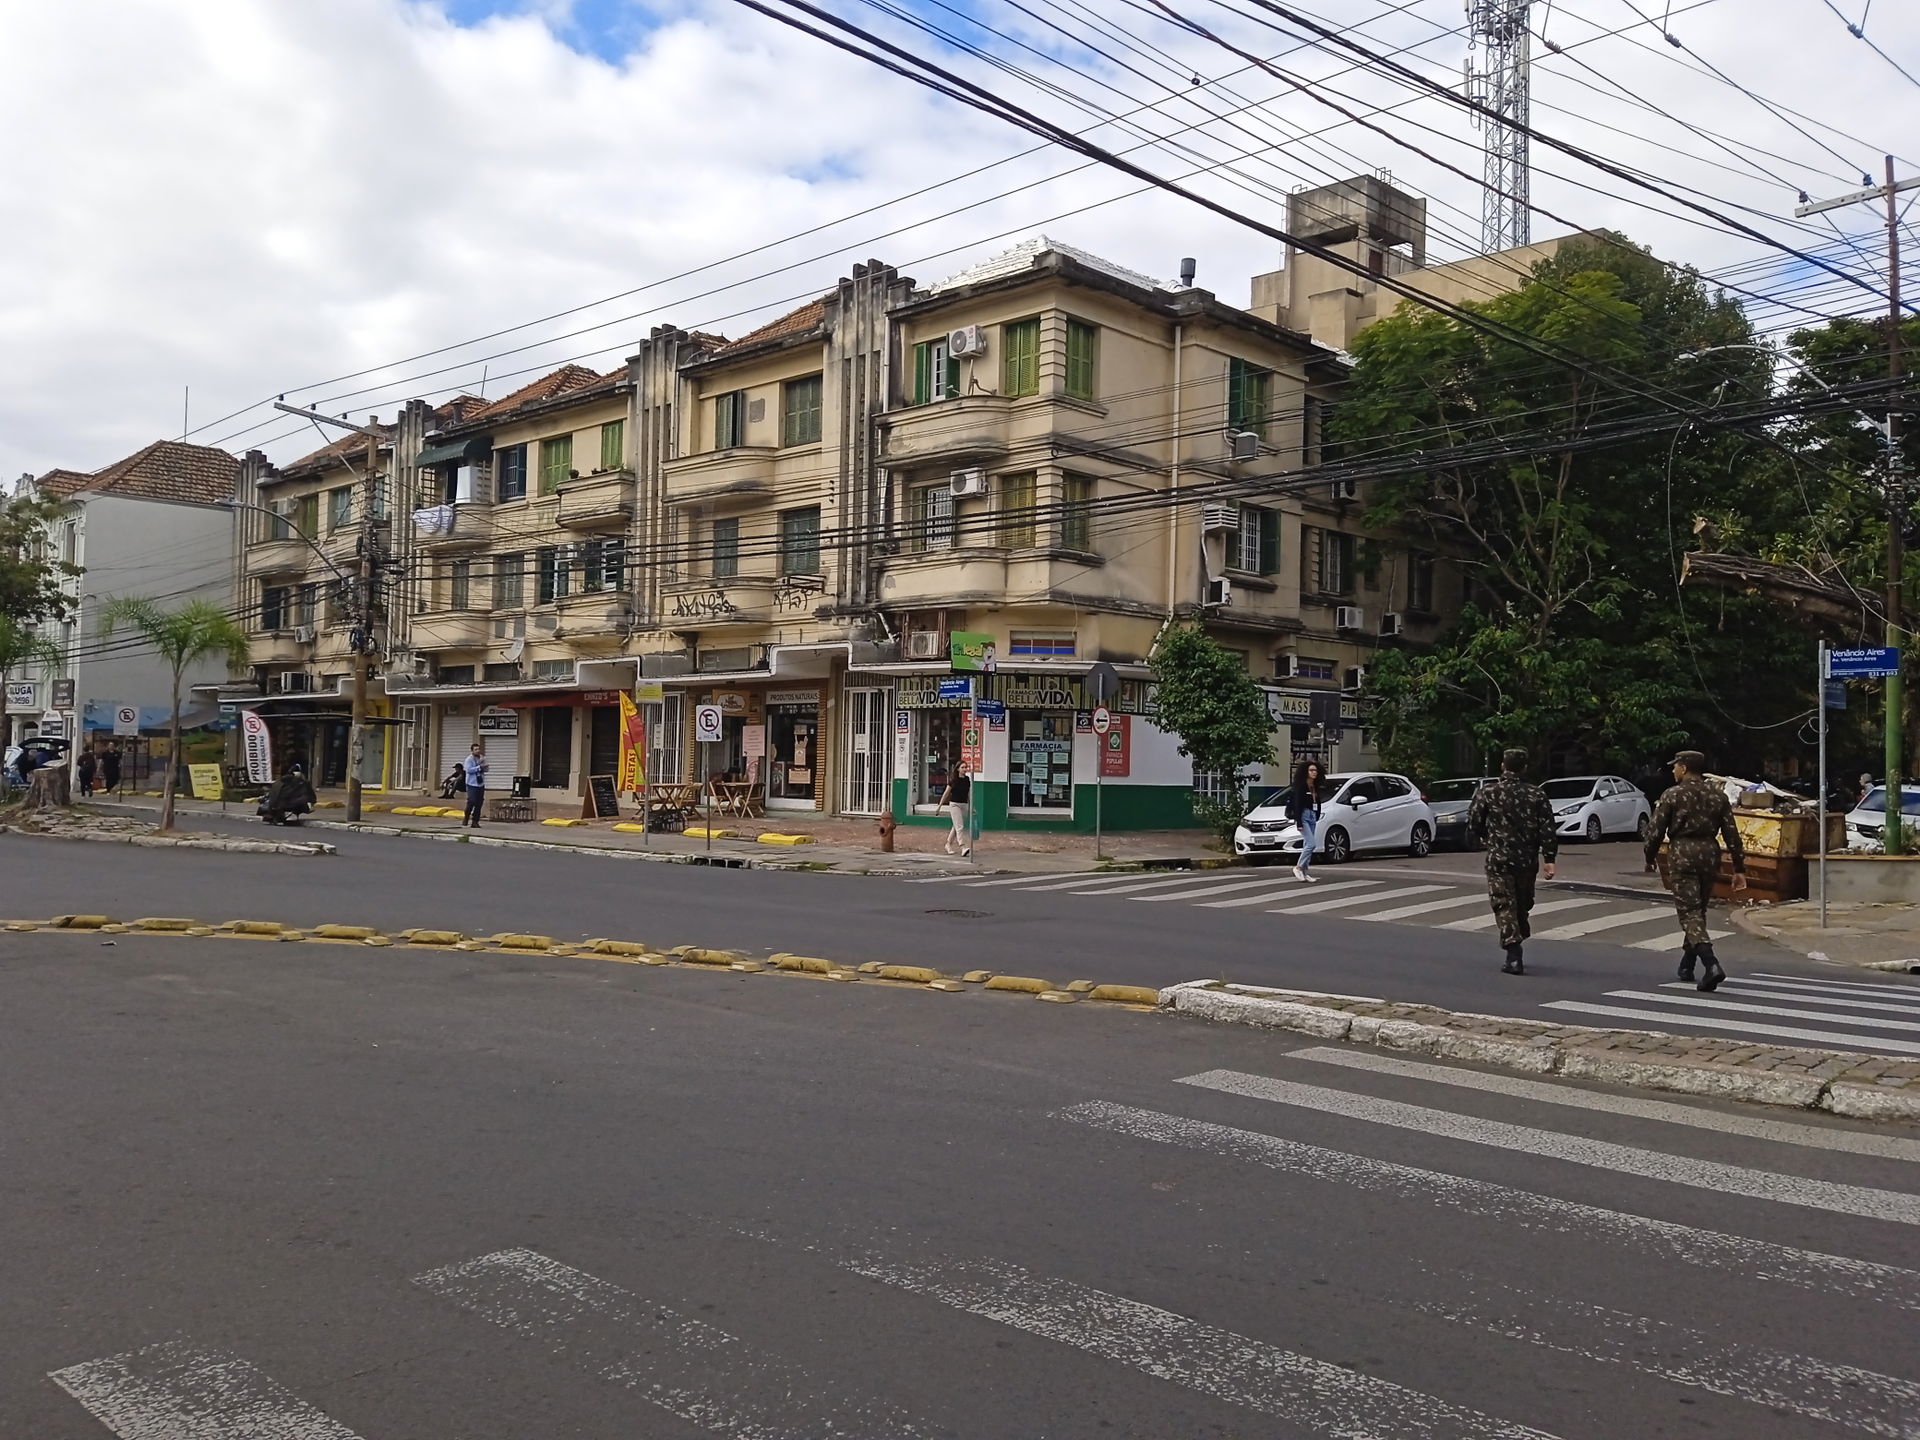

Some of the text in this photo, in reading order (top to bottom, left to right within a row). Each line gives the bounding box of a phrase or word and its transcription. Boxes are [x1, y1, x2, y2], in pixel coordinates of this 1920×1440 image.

[1832, 648, 1885, 657] Venâncio Aires
[1038, 691, 1074, 704] VIDA
[248, 734, 260, 782] PROIBIDO
[626, 752, 636, 791] PALETAS
